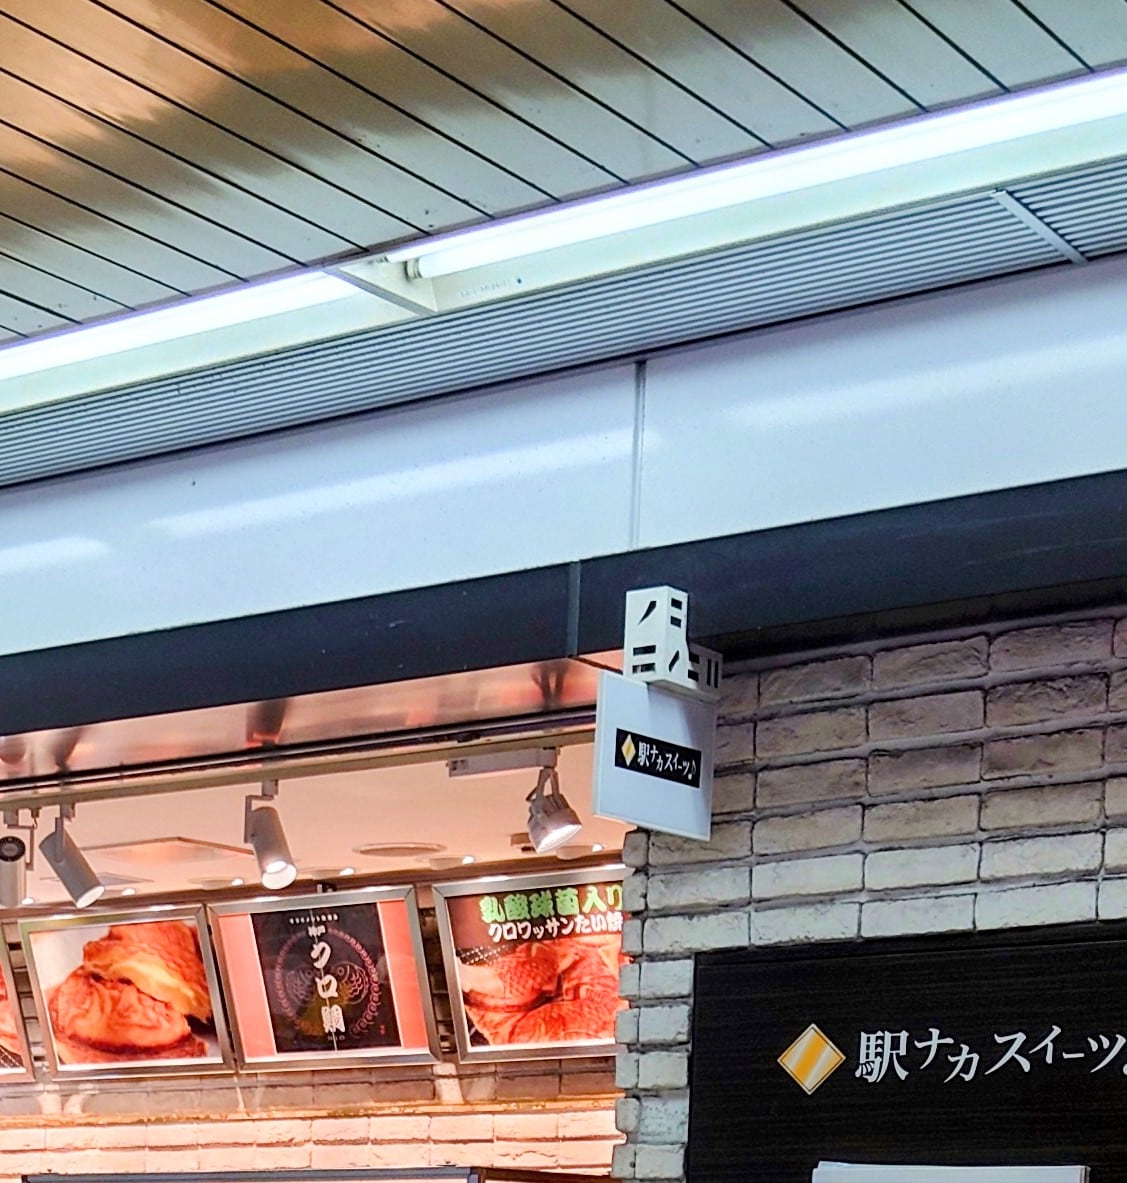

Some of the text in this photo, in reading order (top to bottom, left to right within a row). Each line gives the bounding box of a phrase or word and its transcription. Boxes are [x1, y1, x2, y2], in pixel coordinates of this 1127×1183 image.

[638, 741, 690, 777] 駅ナカスイーツ
[855, 1025, 1126, 1084] 駅ナカスイーツ
